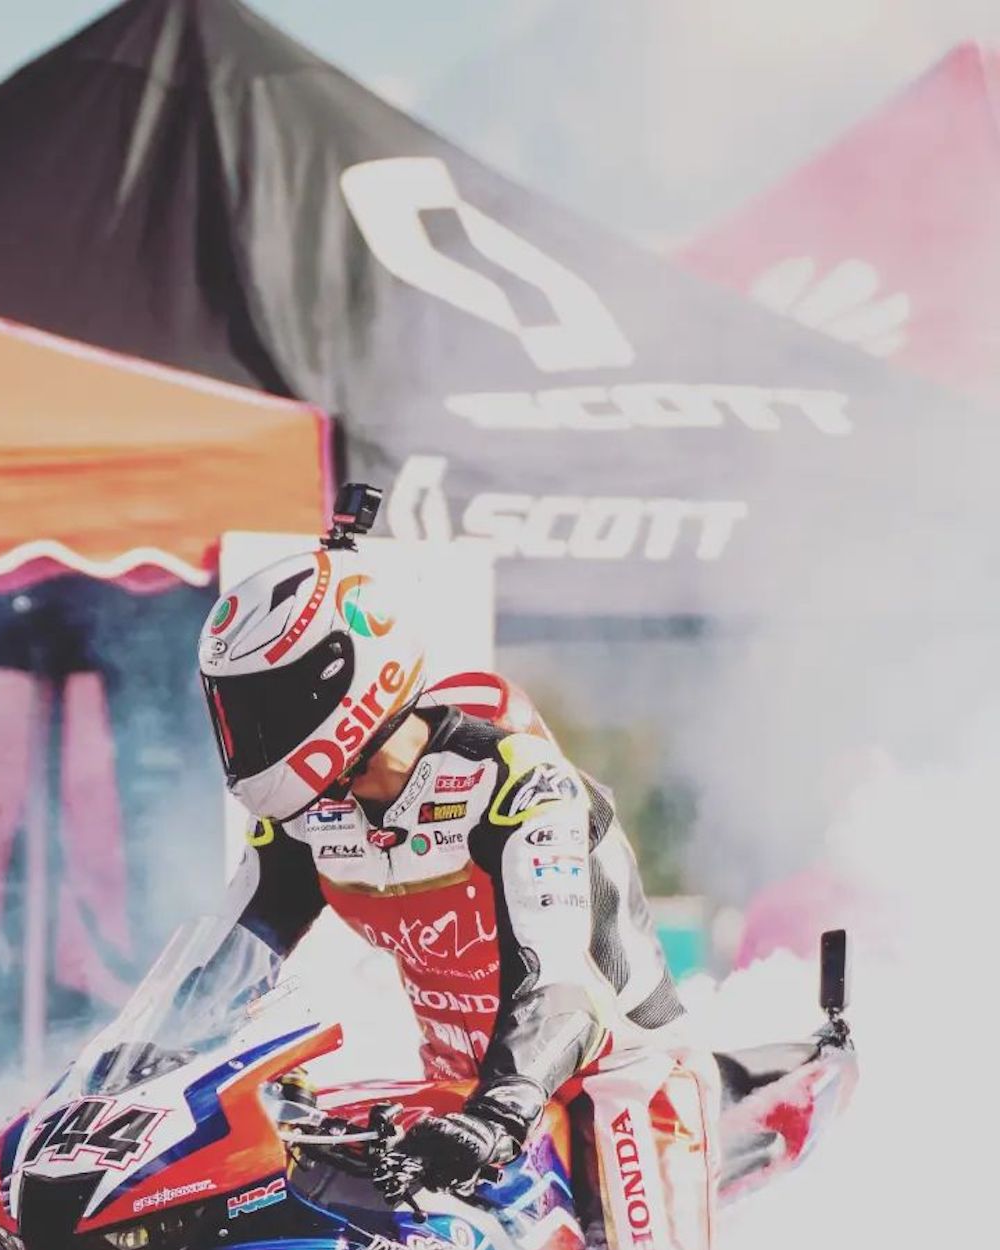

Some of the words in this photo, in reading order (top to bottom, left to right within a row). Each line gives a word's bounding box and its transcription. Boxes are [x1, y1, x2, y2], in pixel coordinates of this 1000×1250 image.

[462, 493, 749, 561] SCOTT
[286, 660, 405, 795] Dsire
[433, 830, 464, 846] Dsire
[22, 1097, 168, 1168] 144
[227, 1178, 287, 1219] HRC
